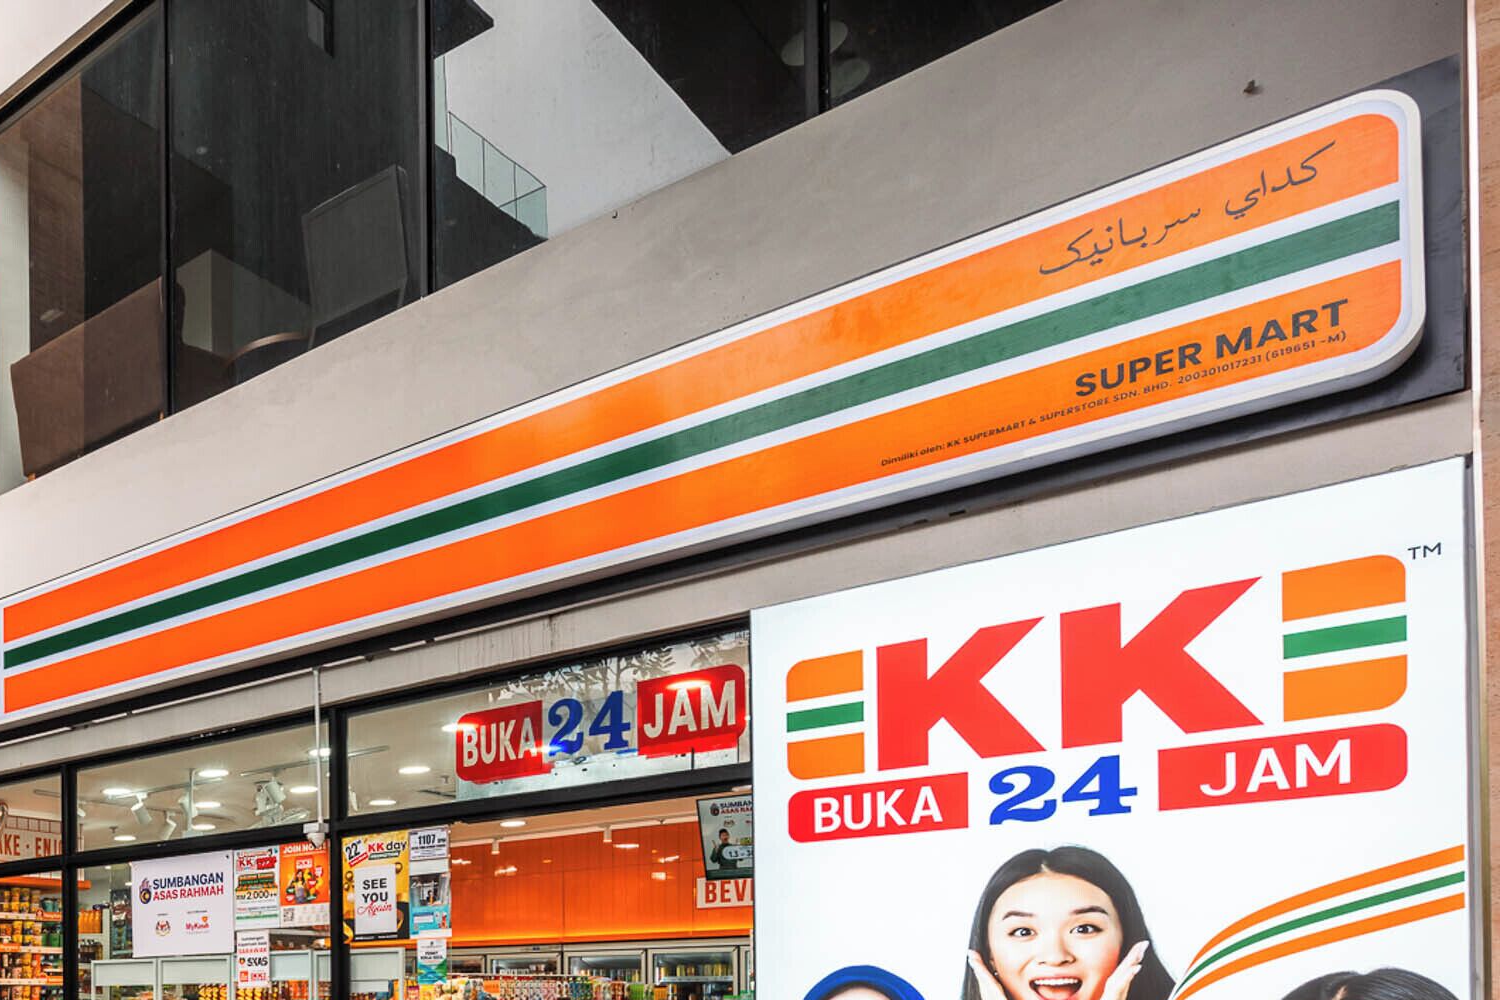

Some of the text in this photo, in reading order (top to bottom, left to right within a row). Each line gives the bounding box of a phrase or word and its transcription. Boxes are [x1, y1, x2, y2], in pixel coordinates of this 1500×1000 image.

[1075, 299, 1349, 397] SUPER MART
[946, 438, 961, 448] KK
[963, 420, 1026, 443] SUPERMART
[1039, 398, 1110, 422] SUPERSTORE
[1113, 389, 1141, 403] SDN.
[1142, 379, 1172, 394] BHD.
[1407, 542, 1443, 561] TM
[875, 576, 1265, 772] KK
[461, 679, 737, 768] BUKA 24 JAM
[813, 739, 1353, 834] BUKA 24 JAM
[368, 842, 385, 853] KK
[386, 840, 407, 852] day
[153, 871, 225, 890] SUMBANGAN
[362, 878, 388, 890] SEE
[153, 885, 225, 902] ASAS RAHMAH
[362, 891, 389, 903] YOU
